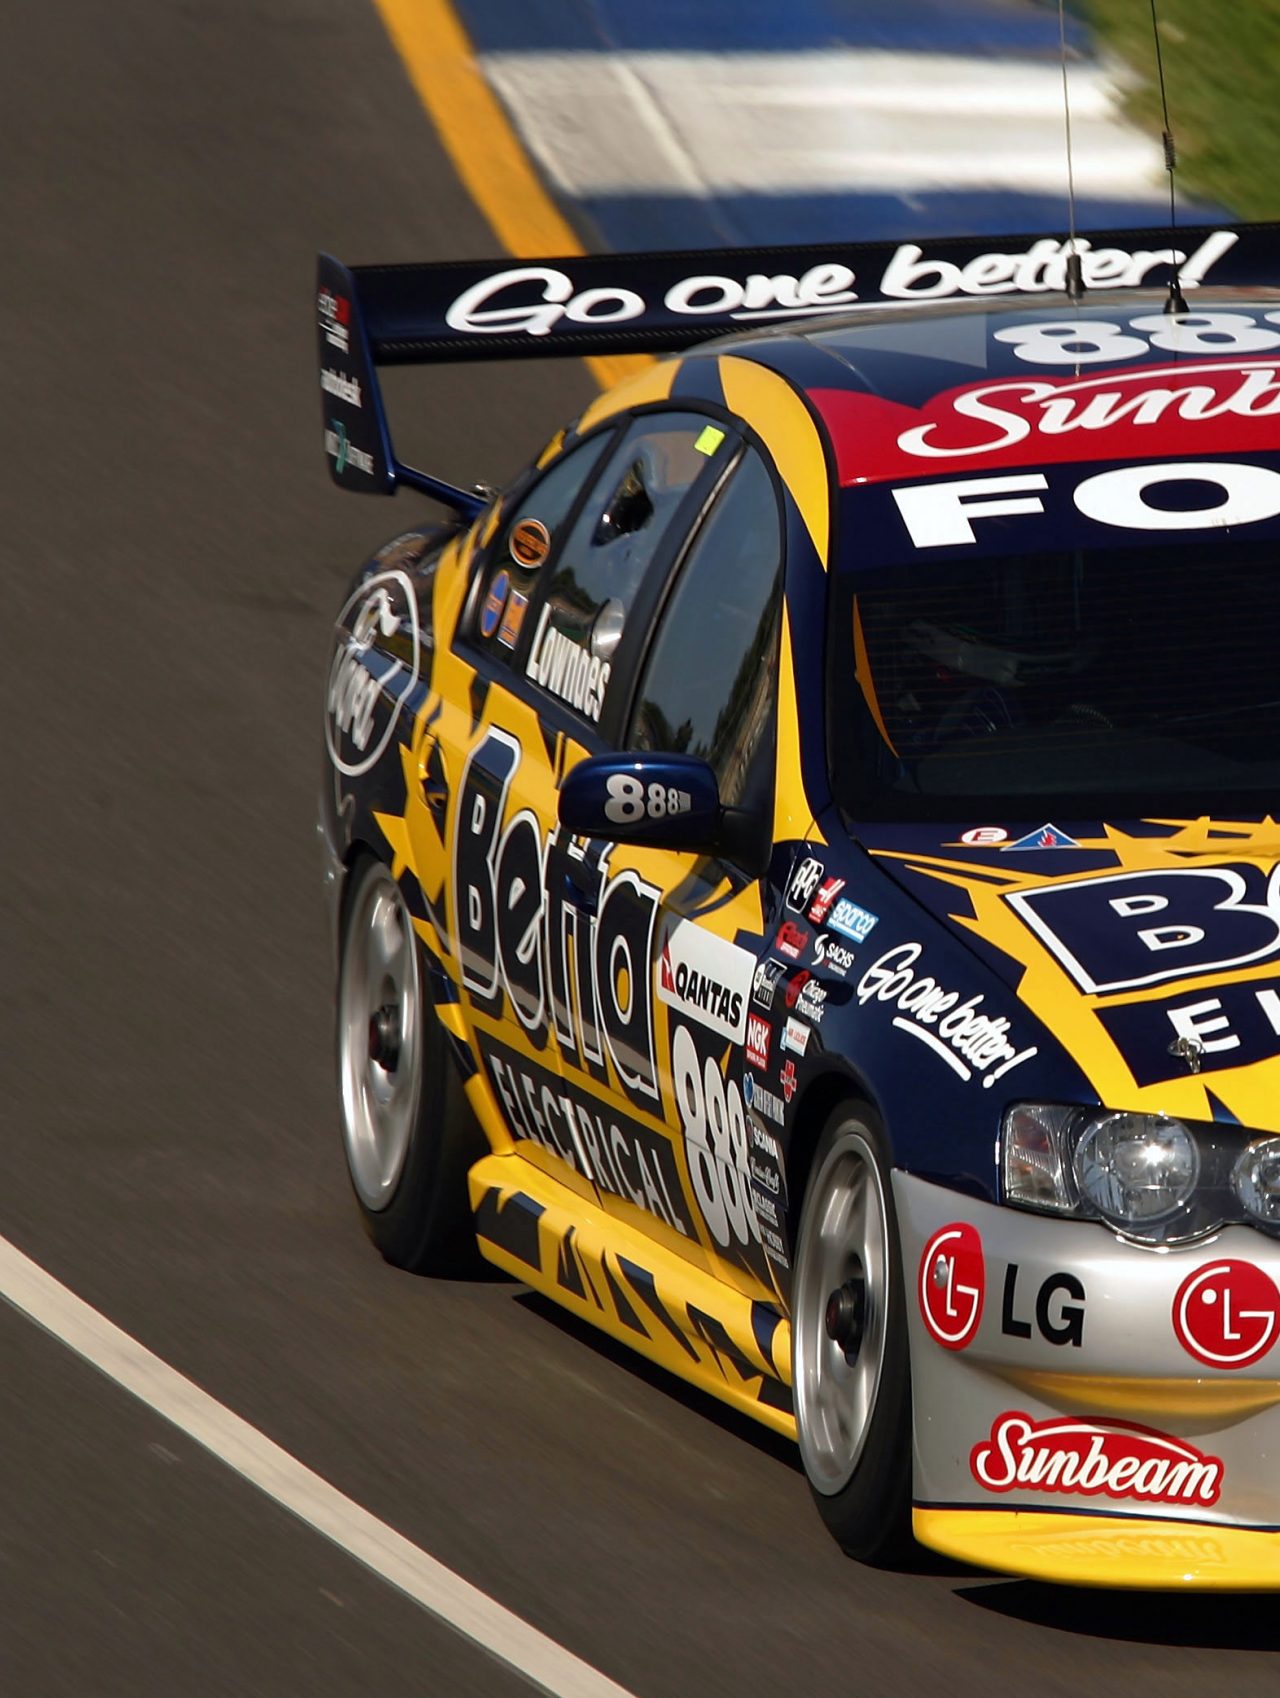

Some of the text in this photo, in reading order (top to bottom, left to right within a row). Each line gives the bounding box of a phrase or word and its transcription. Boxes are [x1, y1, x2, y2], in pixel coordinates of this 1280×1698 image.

[446, 231, 1239, 336] Go one better!
[826, 942, 855, 968] SACHS
[832, 900, 877, 935] sparco
[675, 962, 744, 1029] QANTAS
[747, 1018, 769, 1056] NGK
[857, 942, 1038, 1089] Go one better!
[489, 1053, 689, 1237] ELECTRICAL
[672, 1024, 762, 1248] 888
[1002, 1263, 1087, 1347] LG
[976, 1416, 1220, 1500] Sunbeam
